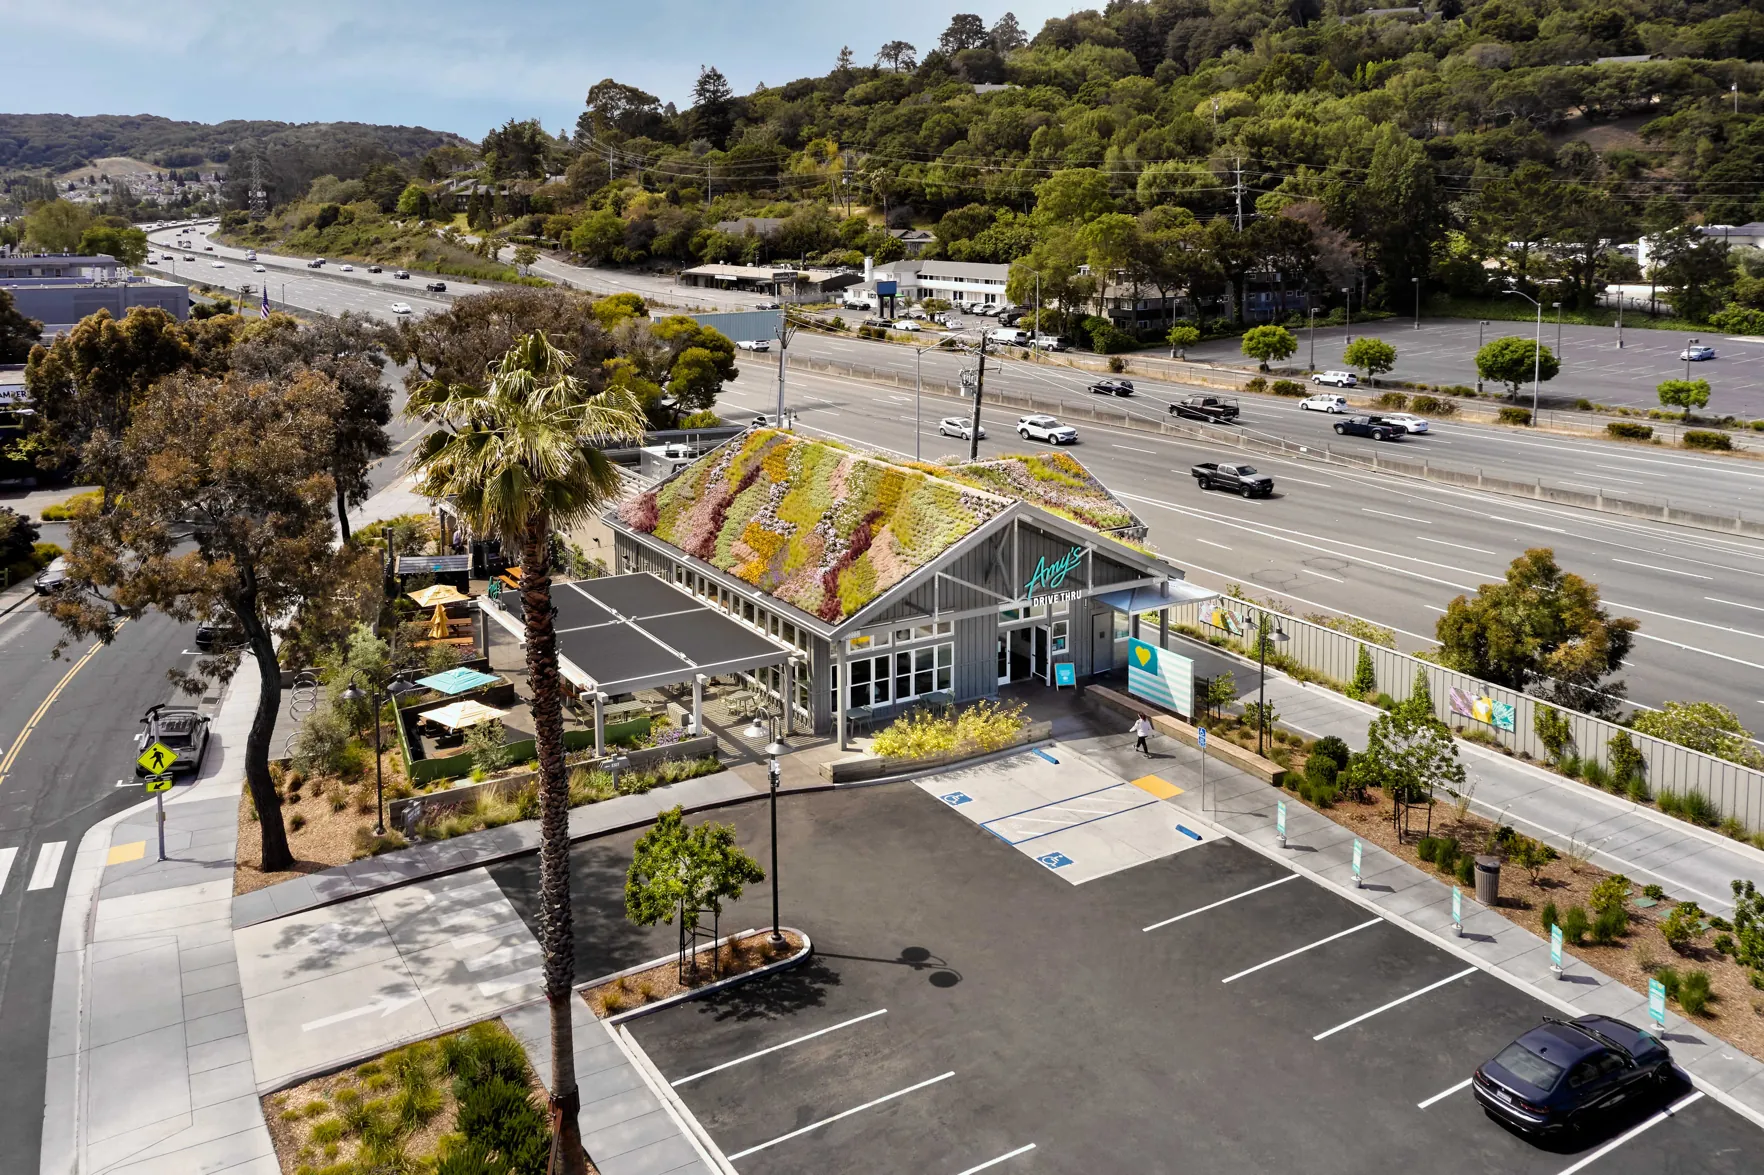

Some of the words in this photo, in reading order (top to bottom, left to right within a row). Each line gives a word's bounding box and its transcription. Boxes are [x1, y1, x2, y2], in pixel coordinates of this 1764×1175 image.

[1025, 546, 1081, 601] Amy's
[1033, 594, 1059, 607] DRIVE
[1060, 589, 1082, 603] THRU
